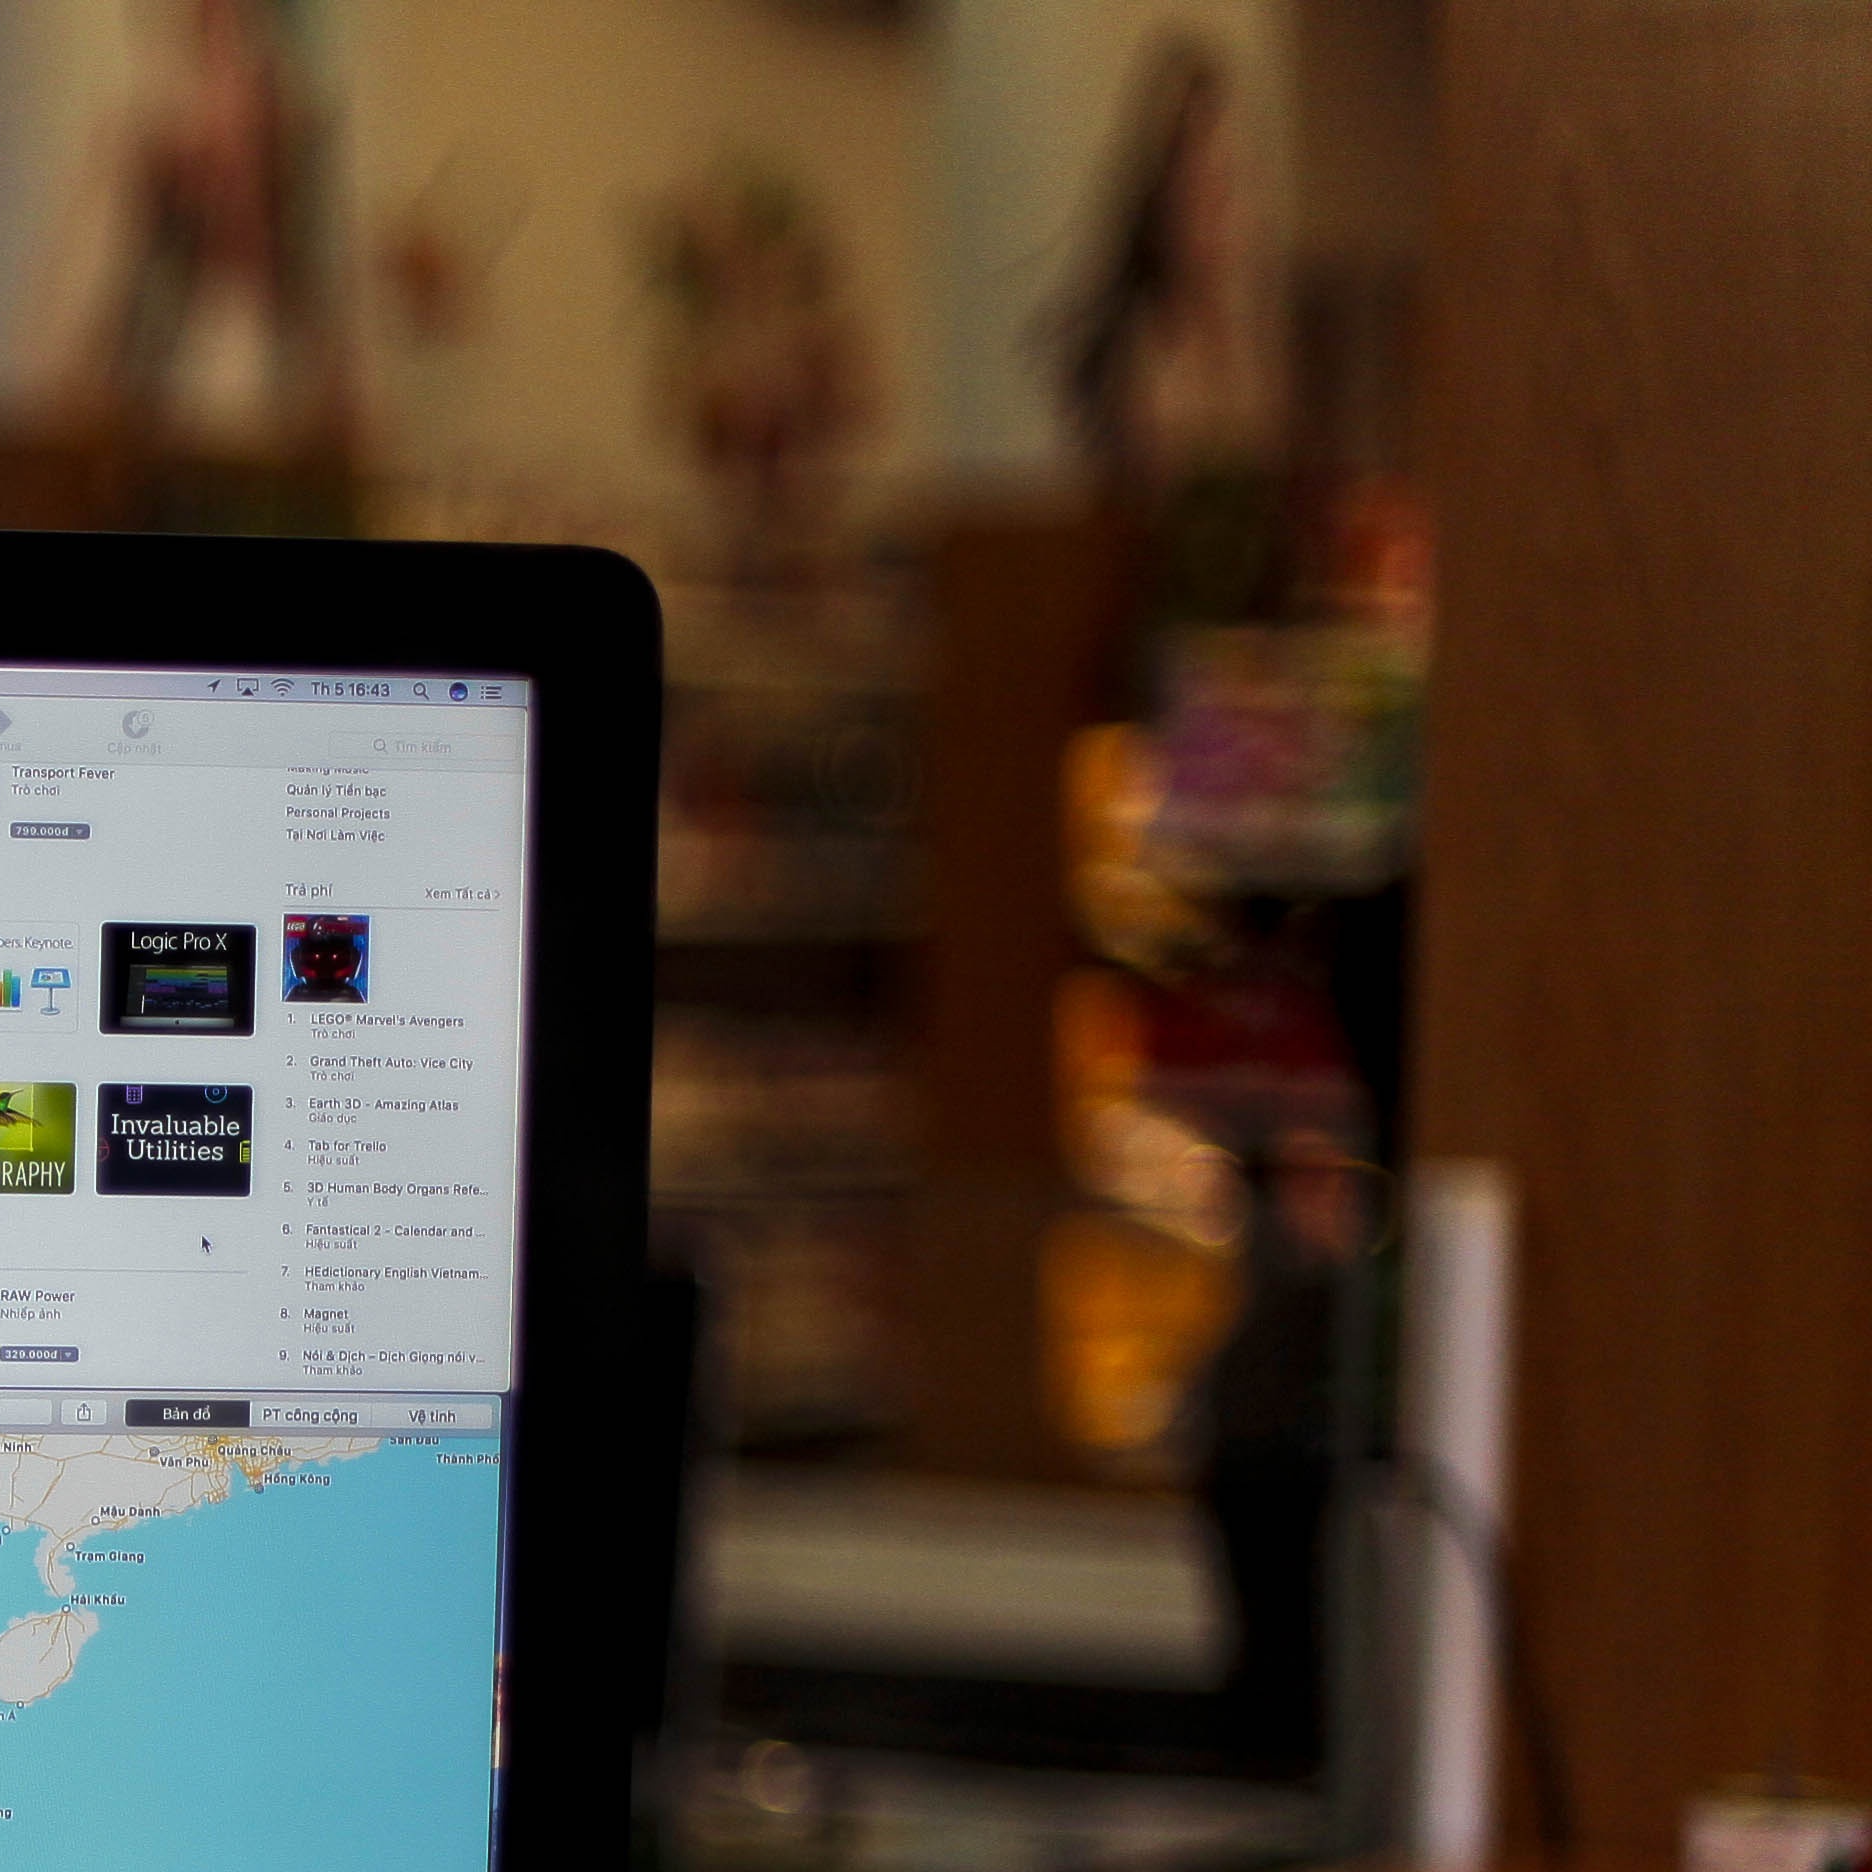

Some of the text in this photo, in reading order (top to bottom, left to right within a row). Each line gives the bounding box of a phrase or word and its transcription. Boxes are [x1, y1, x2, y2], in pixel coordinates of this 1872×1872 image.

[311, 682, 389, 697] Th 5 16:43
[132, 932, 227, 953] Logic Pro X
[357, 1015, 405, 1025] Marvel's
[410, 1016, 463, 1029] Avengers
[311, 1056, 346, 1067] Grand
[350, 1057, 381, 1067] Theft
[421, 1058, 445, 1068] Vice
[450, 1059, 472, 1071] City
[111, 1113, 239, 1136] Invaluable
[127, 1139, 223, 1161] Utilities
